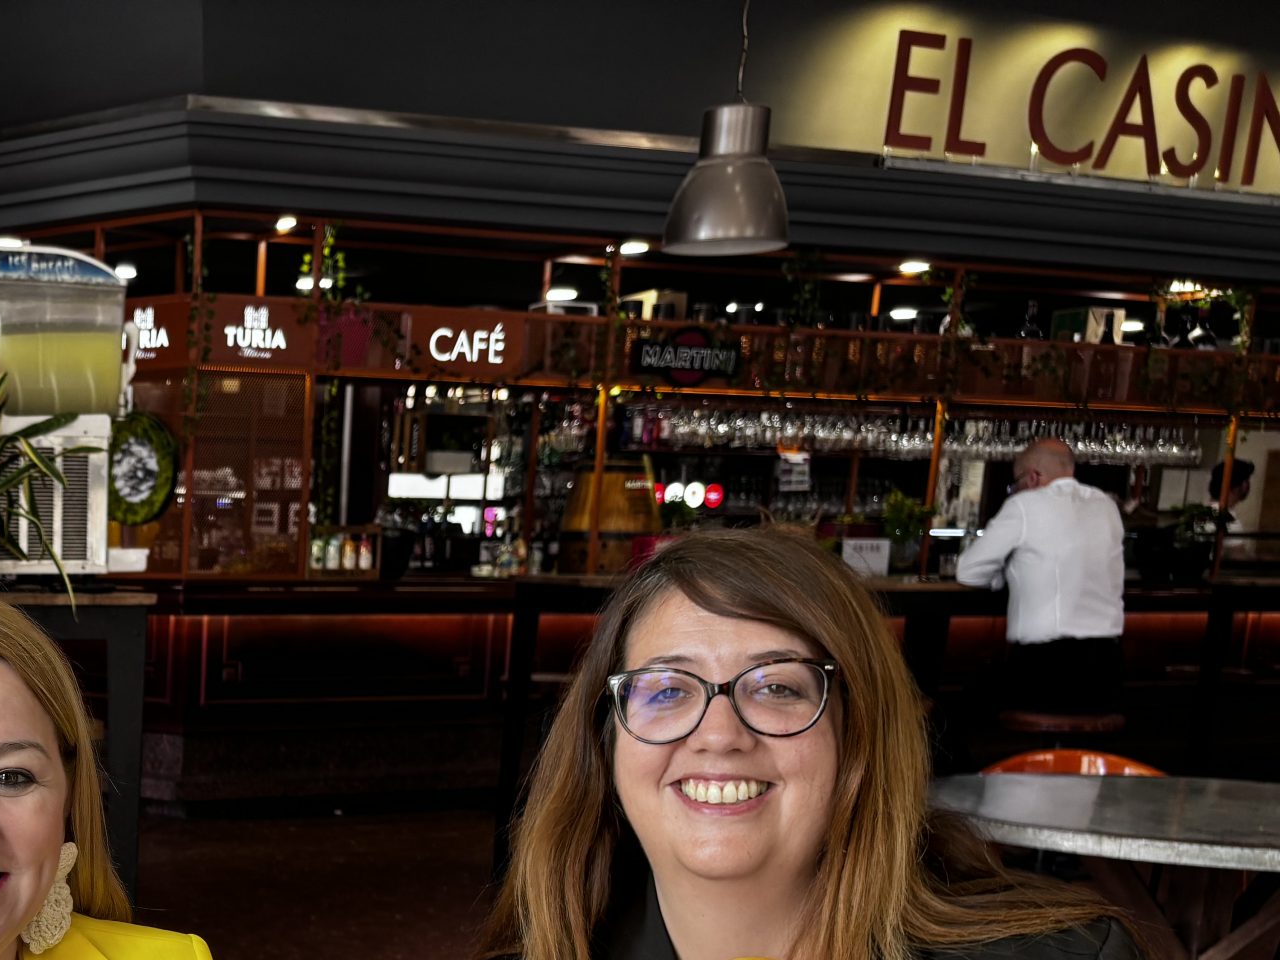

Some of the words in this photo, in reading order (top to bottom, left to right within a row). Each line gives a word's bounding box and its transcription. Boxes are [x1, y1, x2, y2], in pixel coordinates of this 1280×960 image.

[884, 30, 986, 157] EL
[1028, 48, 1280, 186] CASIN
[121, 327, 170, 350] RIA
[224, 325, 287, 350] TURIA
[429, 321, 506, 364] CAFÉ
[640, 343, 736, 374] MARTINI
